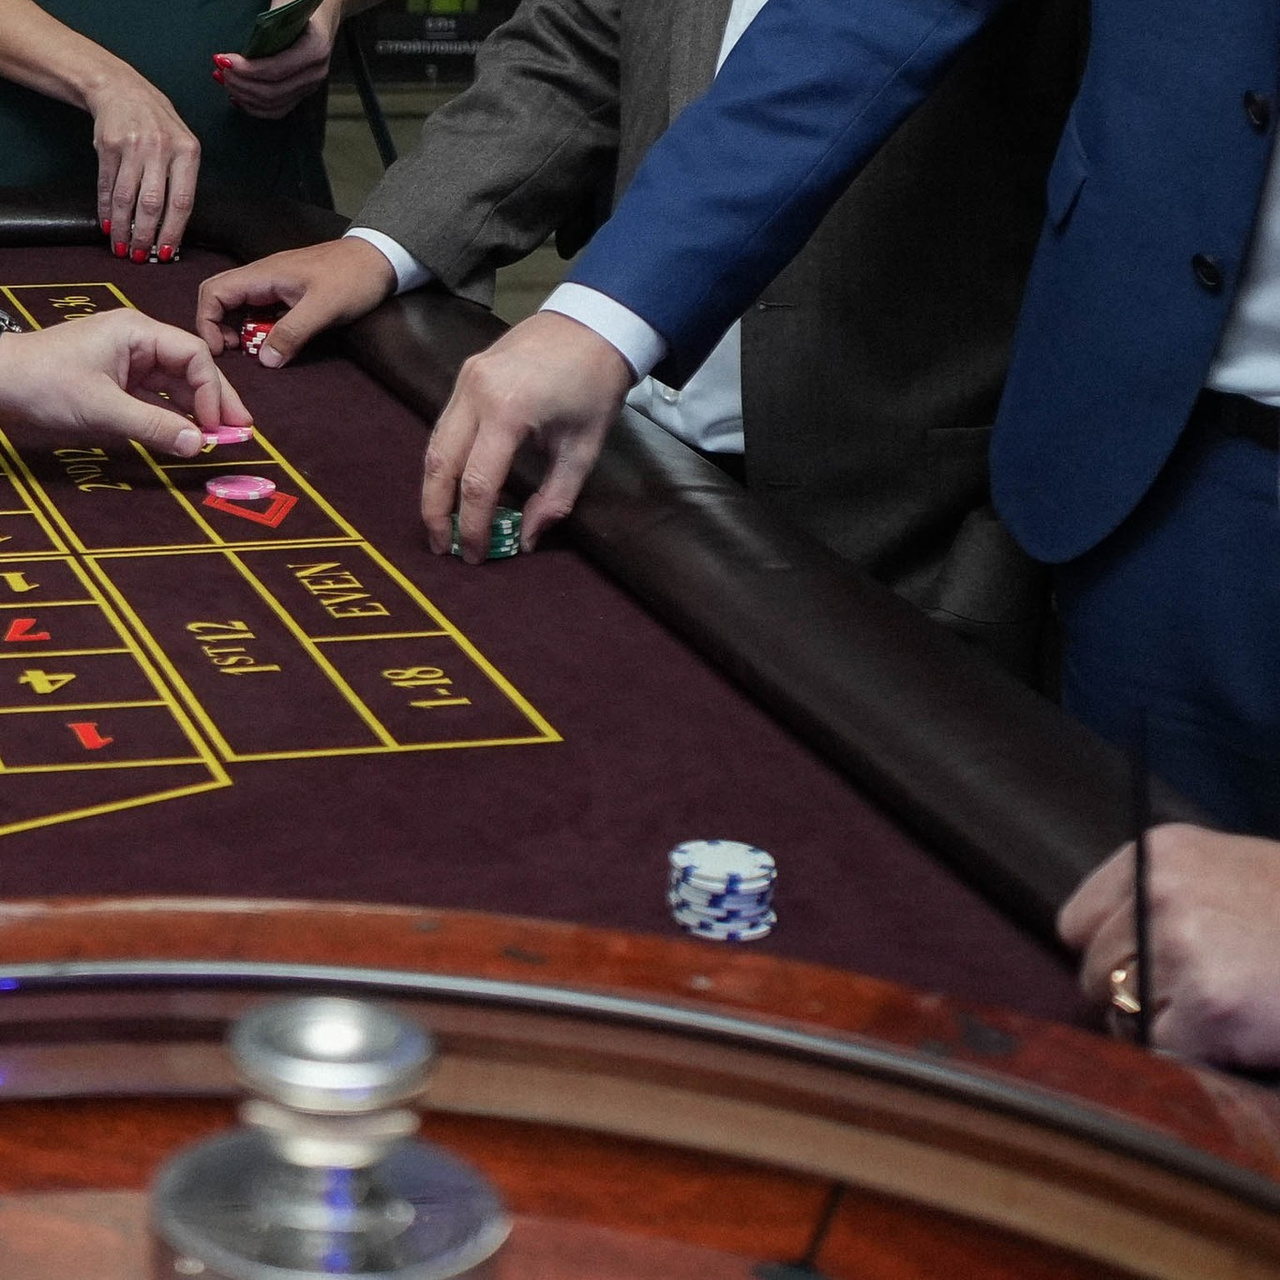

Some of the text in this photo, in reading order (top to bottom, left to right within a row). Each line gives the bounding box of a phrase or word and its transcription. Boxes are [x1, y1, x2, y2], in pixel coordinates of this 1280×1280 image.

[286, 562, 391, 619] EVEN
[3, 618, 52, 643] 7
[17, 670, 76, 695] 4
[67, 722, 114, 750] 1
